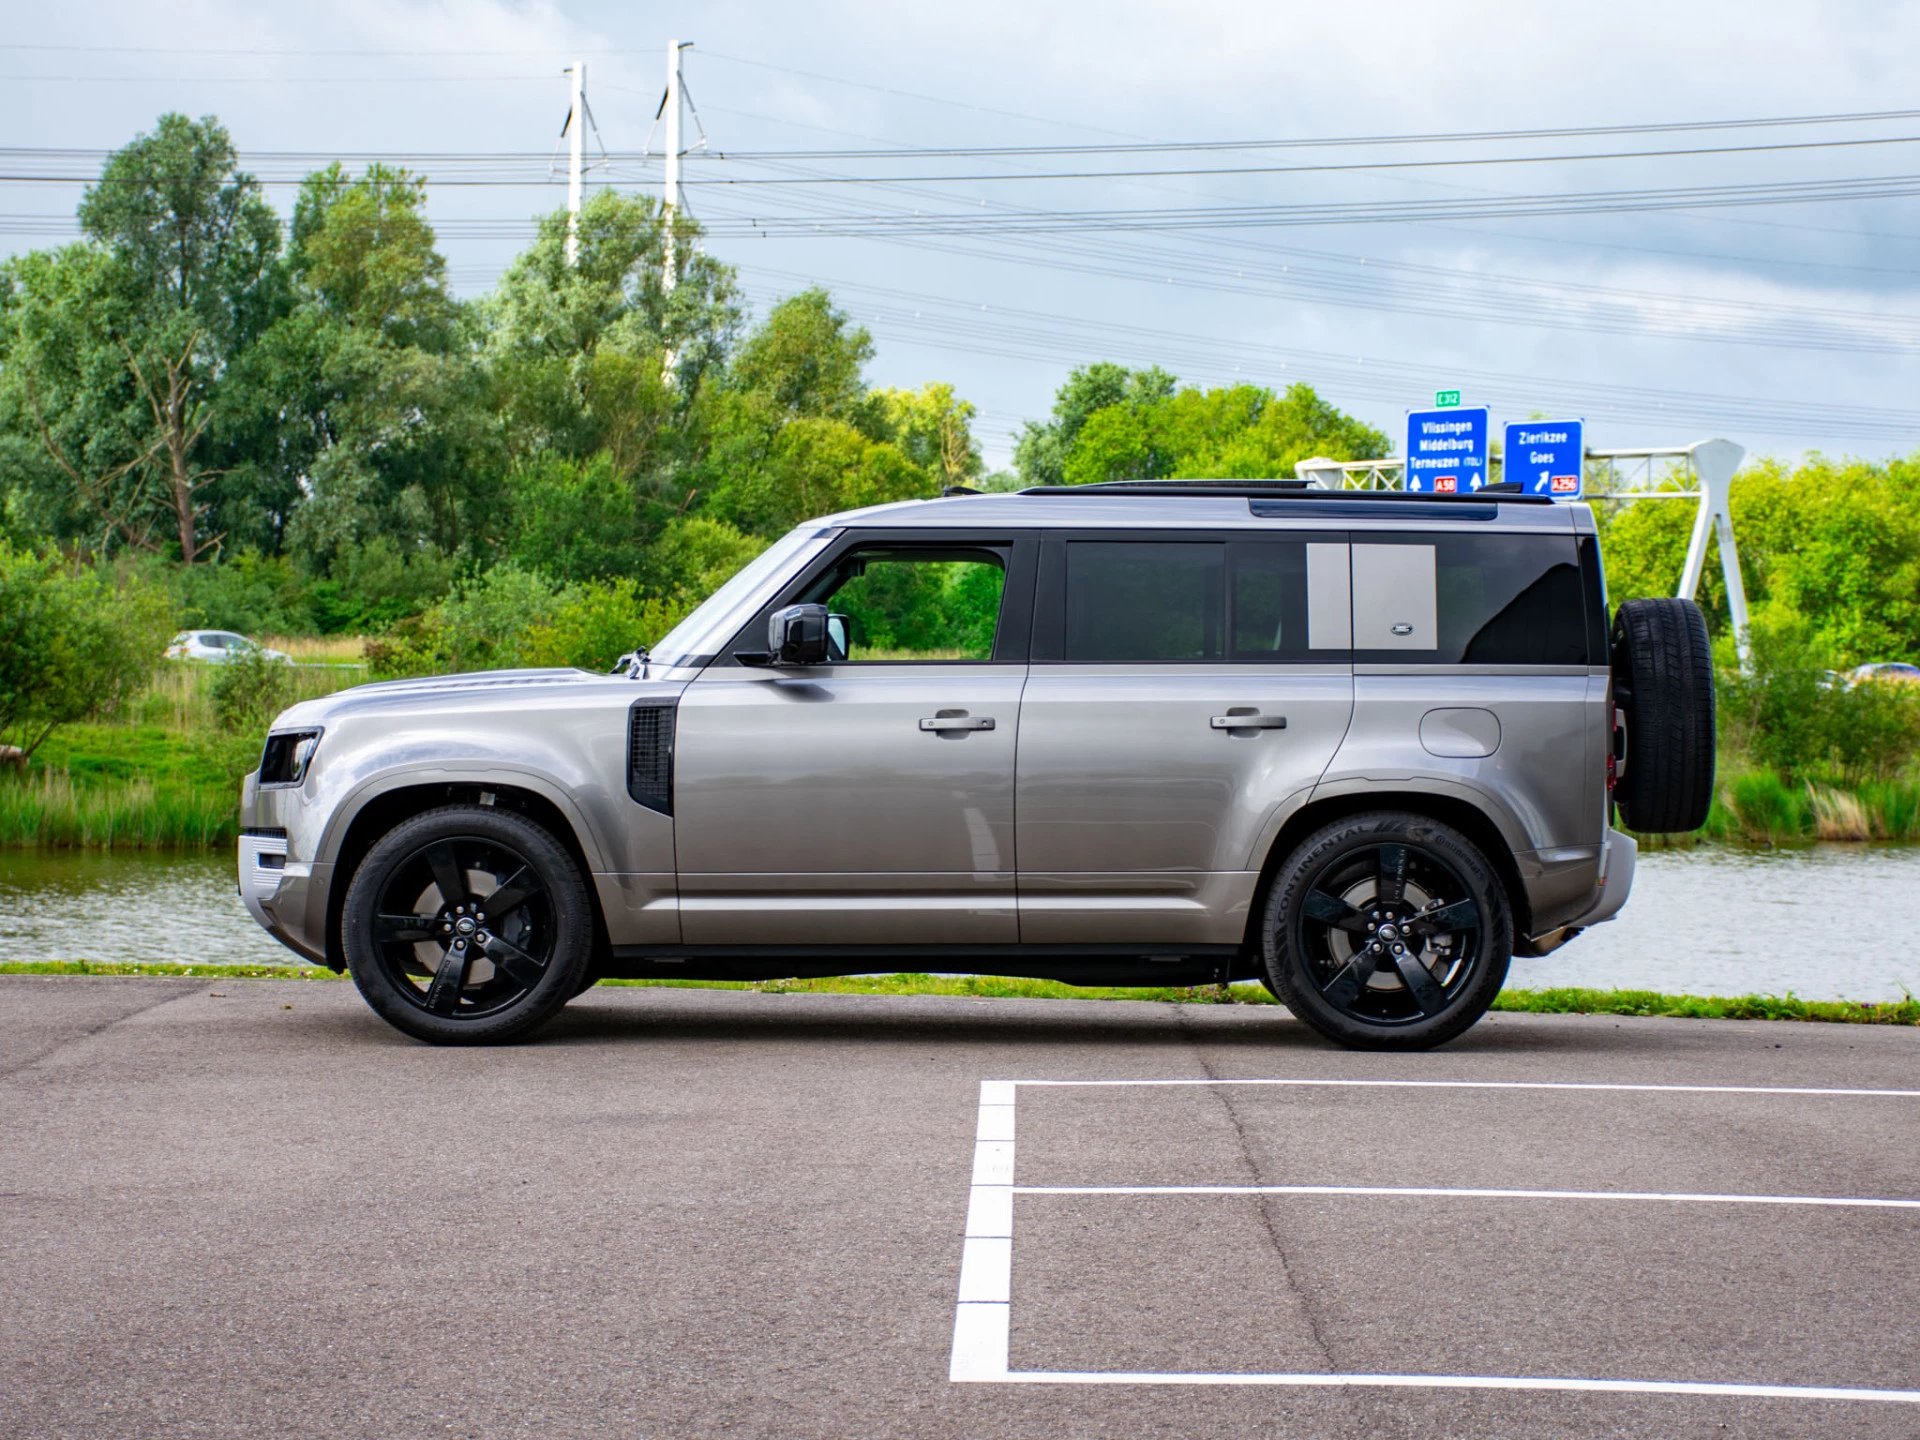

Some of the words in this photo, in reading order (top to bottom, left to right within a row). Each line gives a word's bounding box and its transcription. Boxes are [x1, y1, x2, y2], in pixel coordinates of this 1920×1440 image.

[1421, 421, 1473, 436] Vlissingen
[1518, 431, 1568, 445] Zierikzee
[1419, 438, 1474, 453] Middelburg
[1410, 456, 1460, 469] Terneuzen
[1529, 450, 1555, 464] Goes
[1278, 826, 1369, 923] CONTINENTAL
